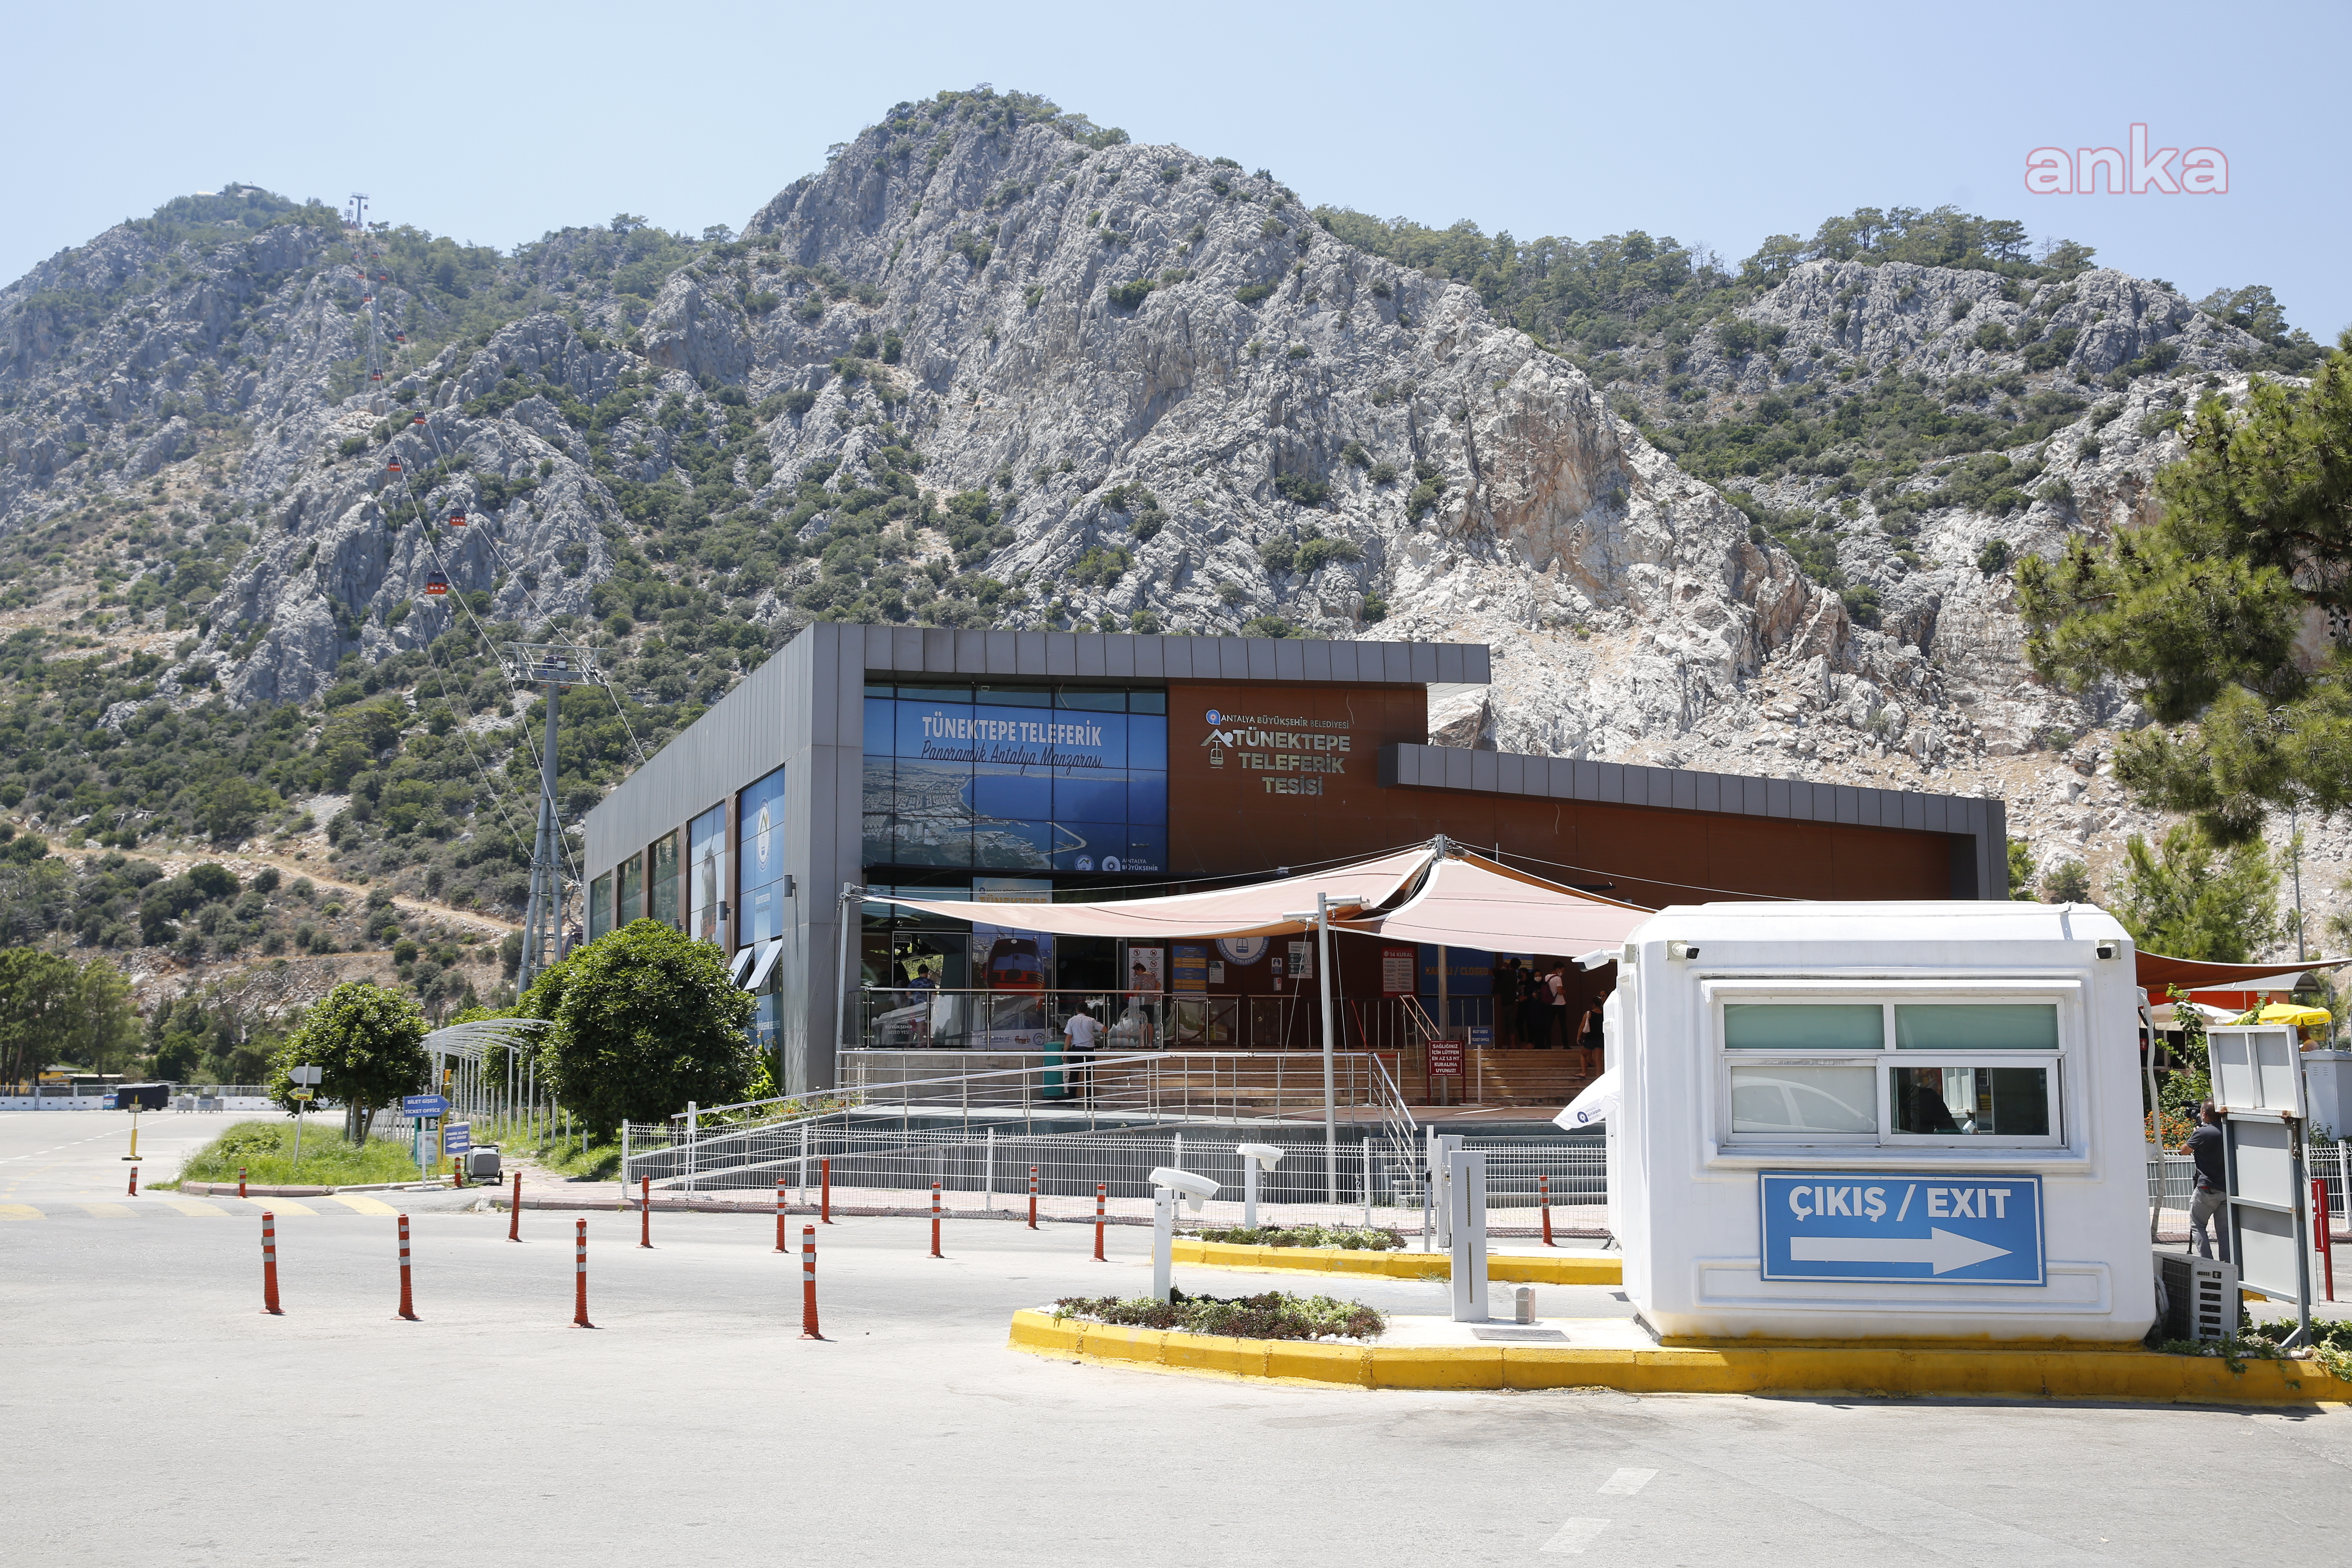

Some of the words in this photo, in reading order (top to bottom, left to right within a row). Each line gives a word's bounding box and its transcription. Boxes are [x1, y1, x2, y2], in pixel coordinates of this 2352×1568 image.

[922, 711, 1016, 741] TÜNEKTEPE
[1019, 720, 1102, 746] TELEFERİK
[1221, 714, 1255, 723] ANTALYA
[1257, 715, 1308, 726] BÜYÜKŞEHİR
[1310, 719, 1349, 729] BELEDİYESİ
[1232, 726, 1350, 752] TÜNEKTEPE
[922, 740, 987, 762] Panoramik
[990, 743, 1037, 775] Antalya
[1041, 746, 1103, 776] Manzarası
[1238, 753, 1345, 774] TELEFERİK
[1262, 775, 1323, 795] TESİSİ
[1237, 954, 1261, 964] TELEFERİK
[1461, 967, 1489, 976] CLOSED
[1788, 1185, 1887, 1222] ÇIKIŞ
[1896, 1184, 1916, 1222] /
[1927, 1188, 2011, 1219] EXIT
